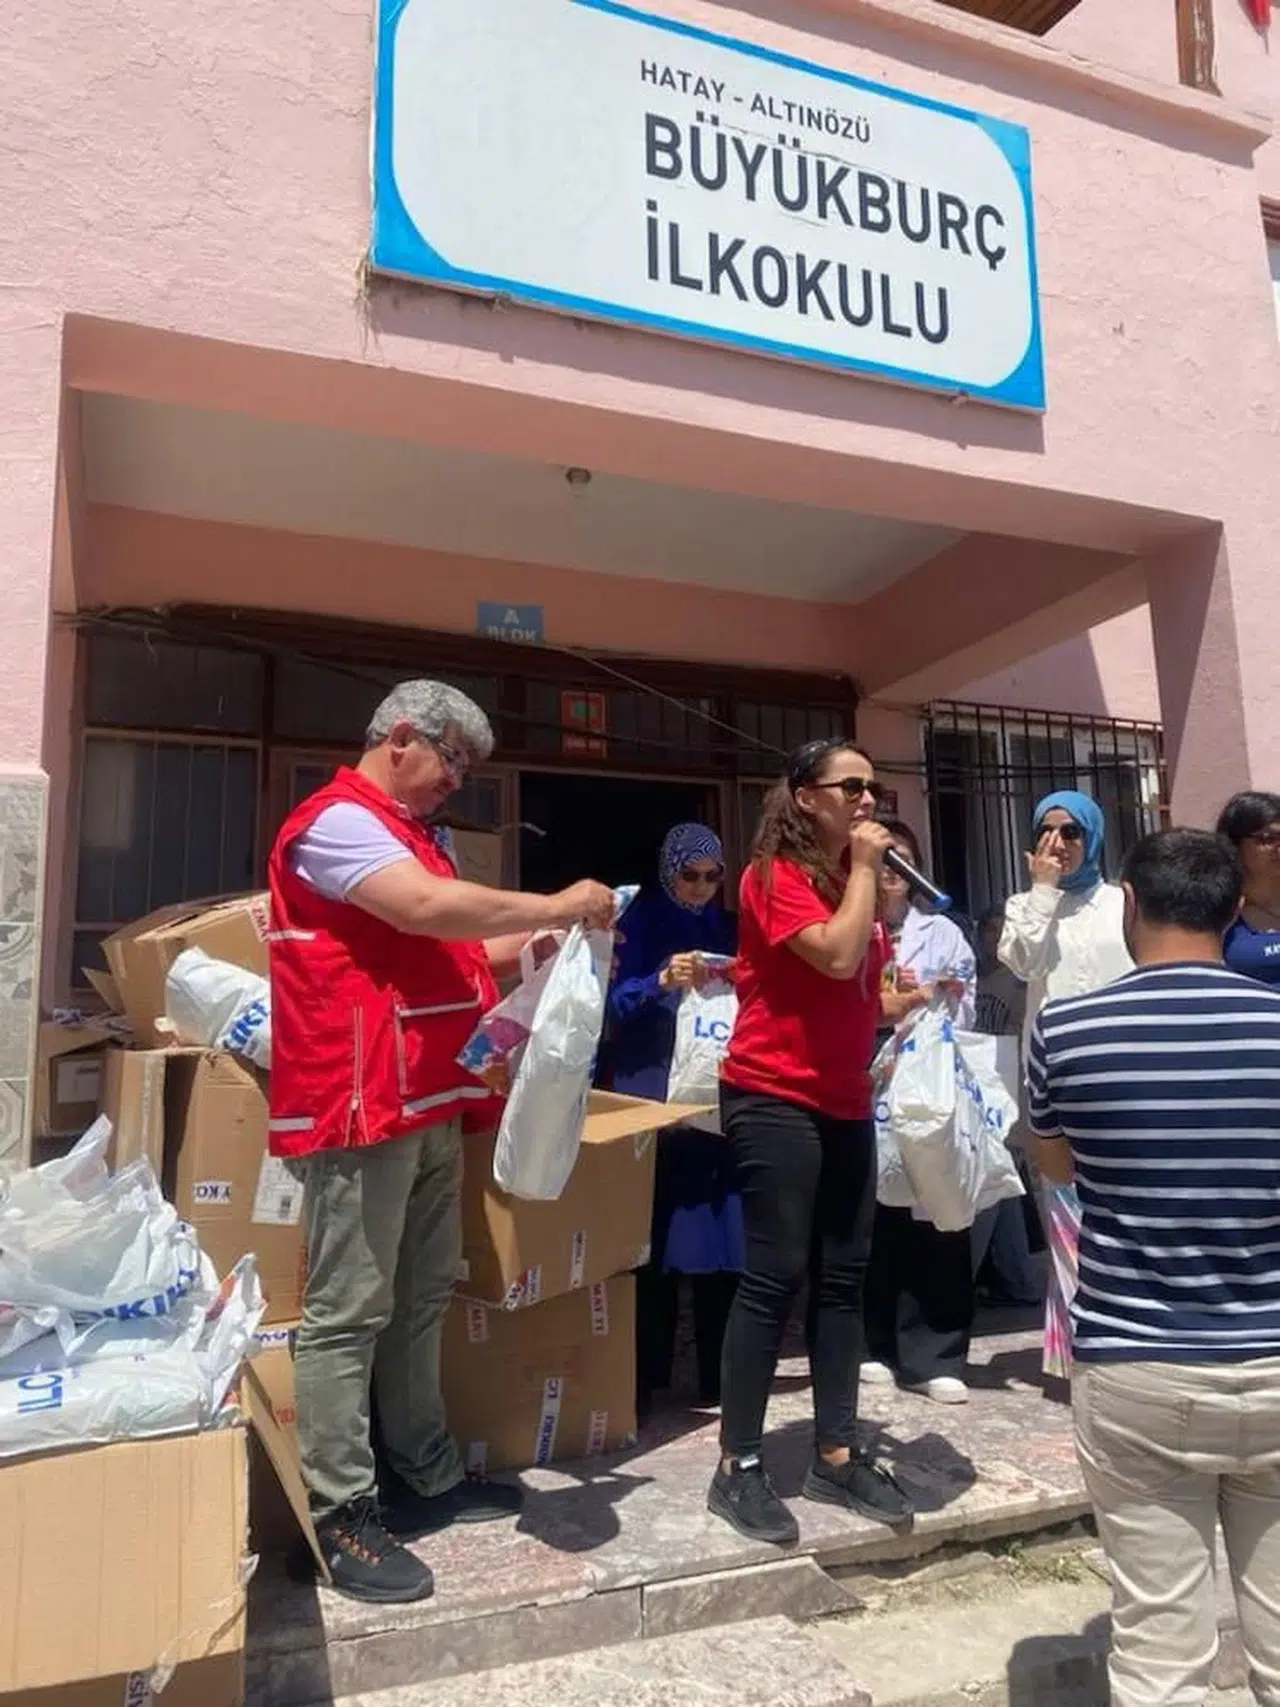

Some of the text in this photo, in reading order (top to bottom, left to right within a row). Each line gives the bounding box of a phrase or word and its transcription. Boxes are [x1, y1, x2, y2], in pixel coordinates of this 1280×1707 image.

[641, 59, 725, 102] HATAY
[750, 92, 870, 143] ALTINÖZÜ
[645, 111, 1007, 270] BÜYÜKBURÇ
[646, 199, 949, 344] İLKOKULU
[504, 607, 520, 625] A
[694, 1016, 730, 1041] LC
